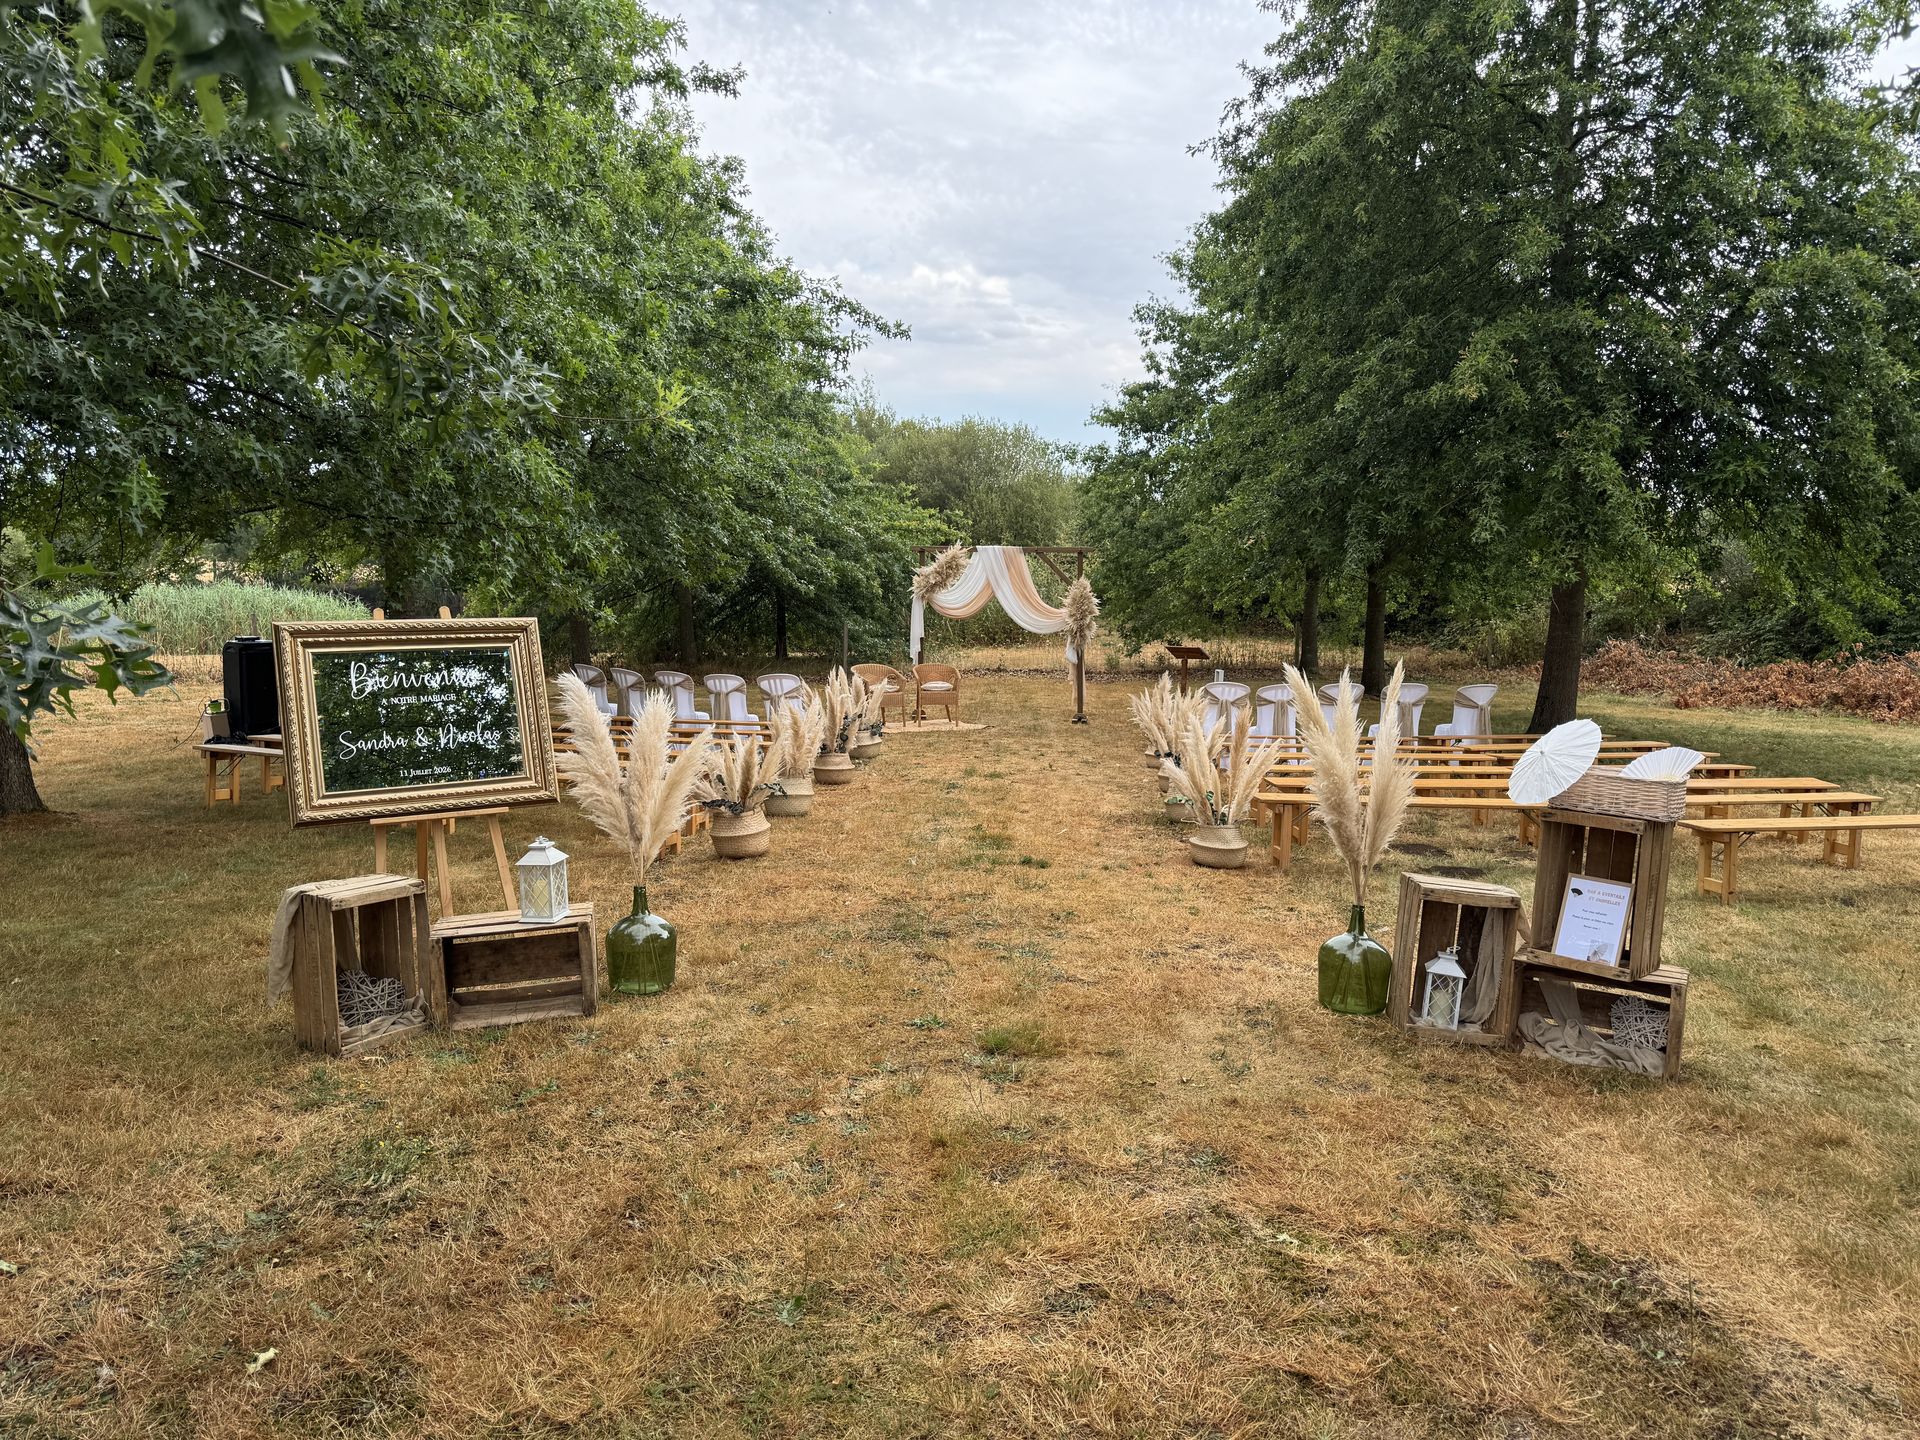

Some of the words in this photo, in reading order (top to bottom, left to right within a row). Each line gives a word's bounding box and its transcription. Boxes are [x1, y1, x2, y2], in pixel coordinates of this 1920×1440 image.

[391, 696, 418, 705] NOTRE
[420, 693, 457, 703] MARIAGE
[339, 730, 409, 760] Sandra
[416, 726, 433, 747] &
[434, 766, 452, 774] 2026
